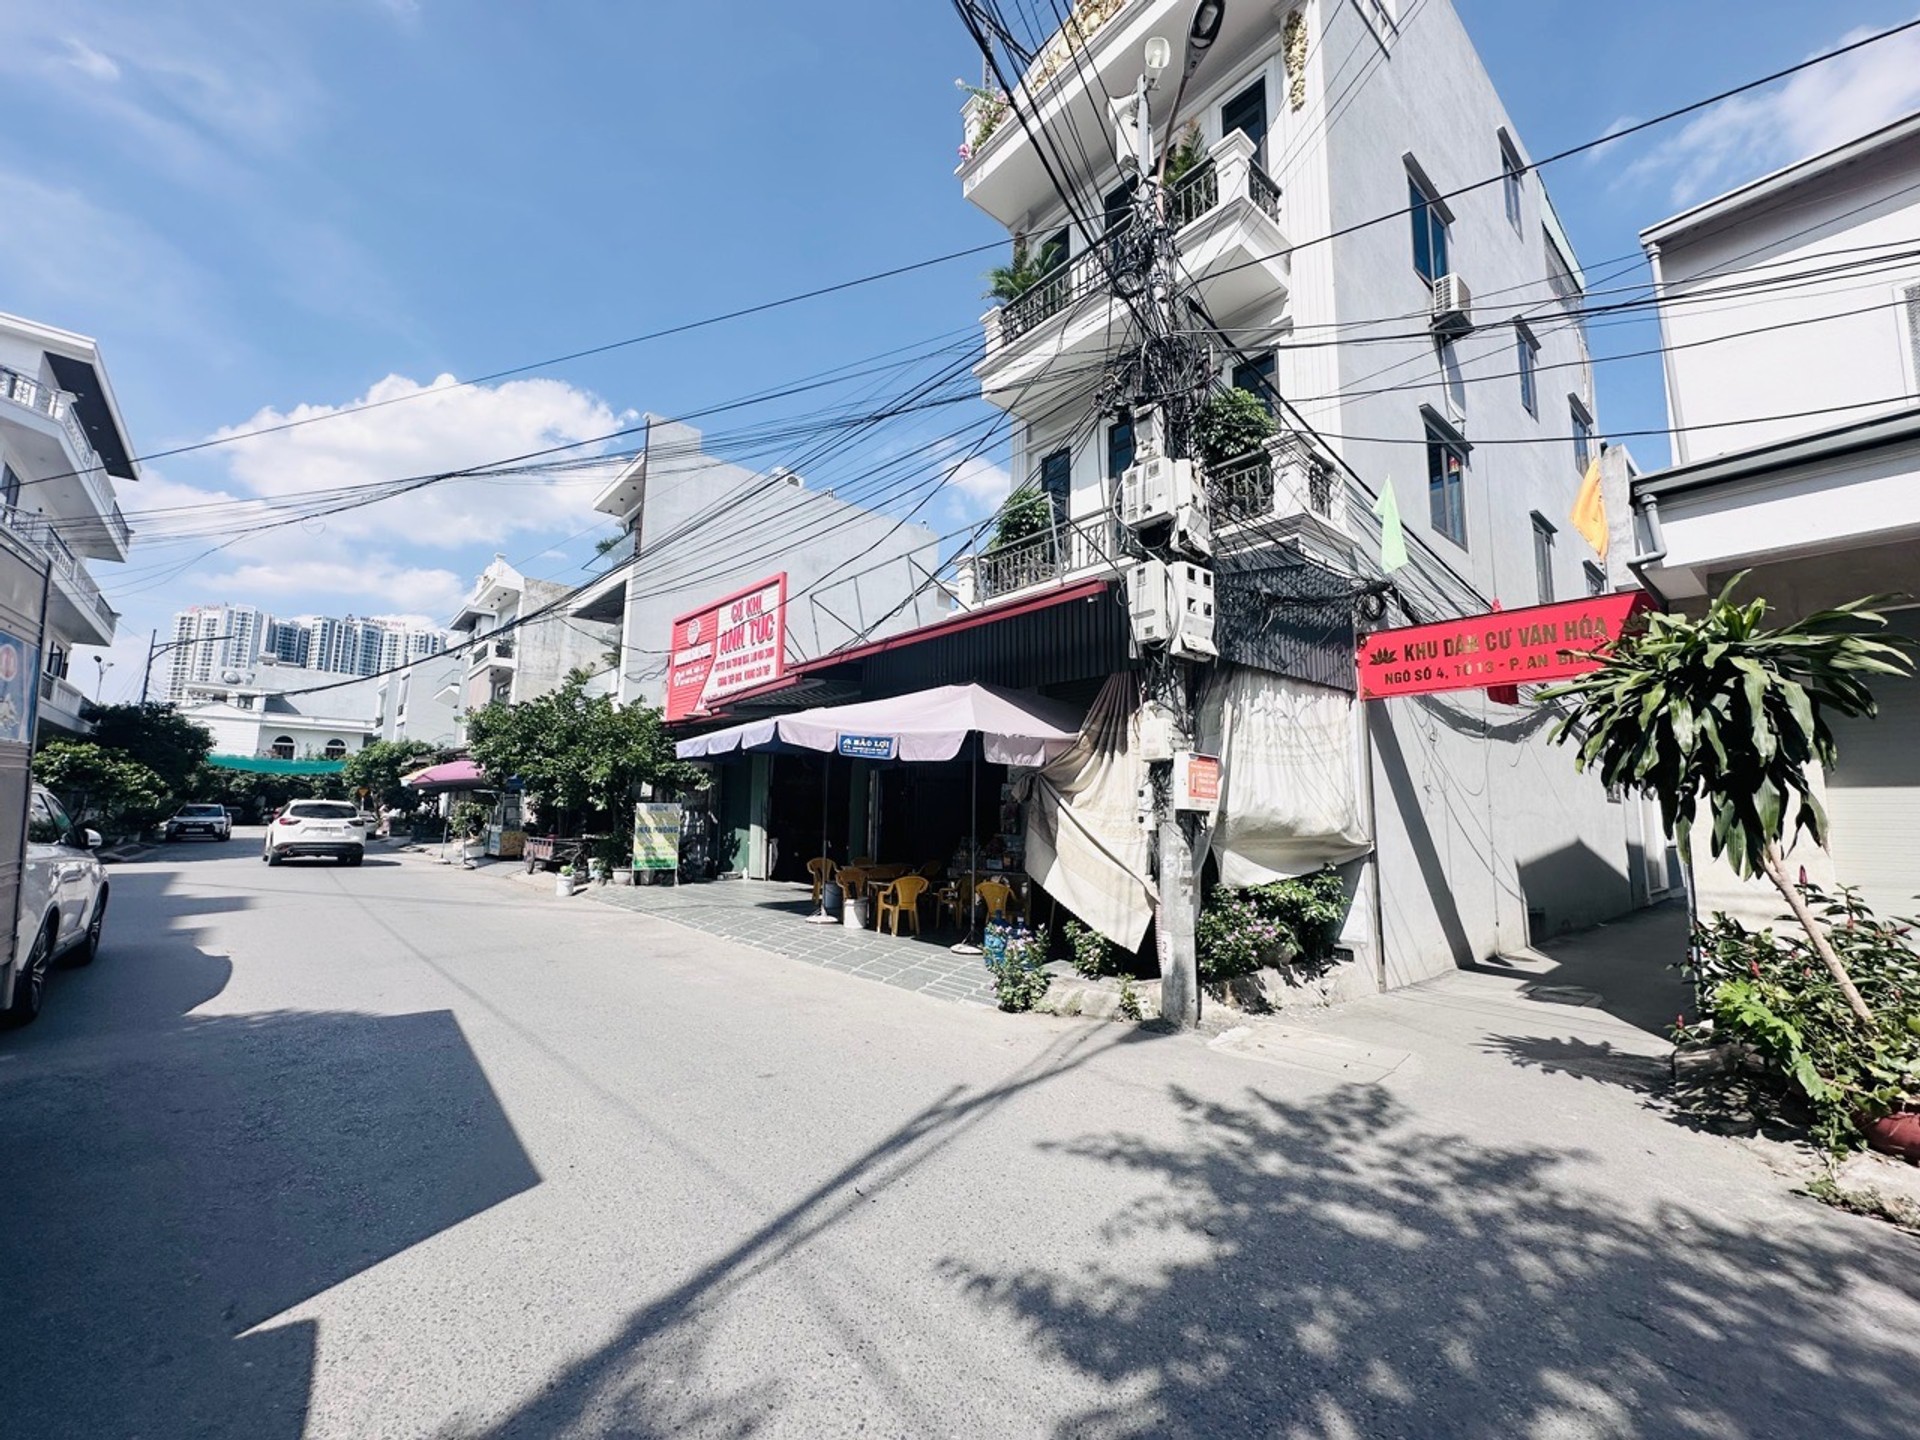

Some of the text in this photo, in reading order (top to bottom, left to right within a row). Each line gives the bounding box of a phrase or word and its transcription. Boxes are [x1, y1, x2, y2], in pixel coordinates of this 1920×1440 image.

[1404, 640, 1438, 662] KHU
[1485, 627, 1512, 651] CƯ
[1563, 613, 1608, 641] HÓA
[1476, 661, 1494, 674] 13
[1527, 654, 1549, 669] AN
